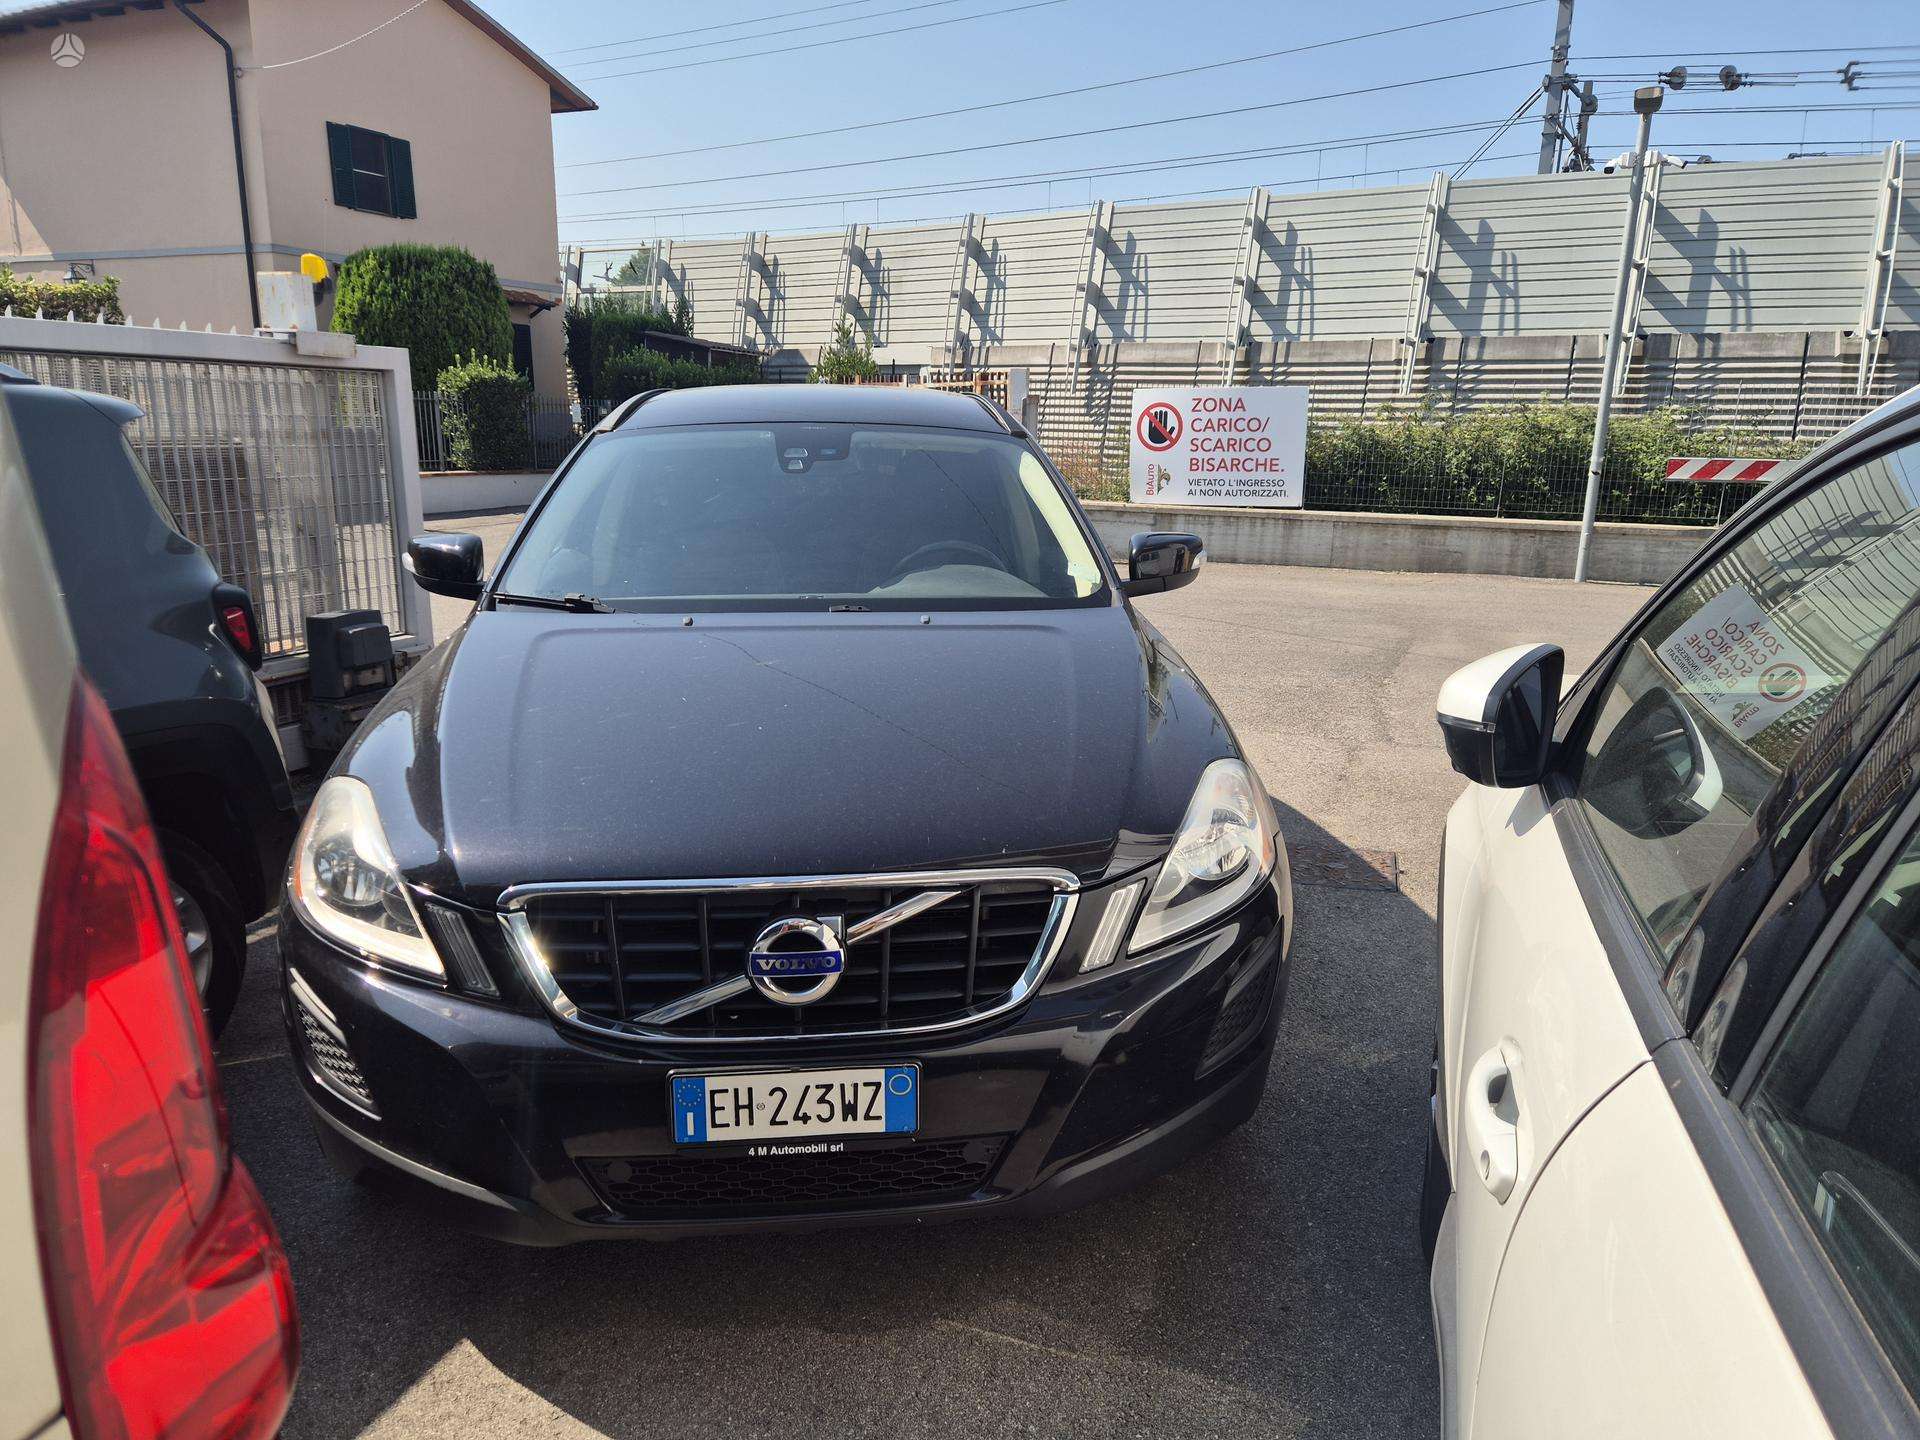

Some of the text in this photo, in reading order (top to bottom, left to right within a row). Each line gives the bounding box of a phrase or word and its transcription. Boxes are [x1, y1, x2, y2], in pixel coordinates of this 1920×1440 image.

[1191, 397, 1247, 413] ZONA
[1190, 416, 1270, 433] CARICO/
[1190, 437, 1272, 453] SCARICO
[1189, 457, 1285, 473] BISARCHE.
[1188, 478, 1285, 488] VIETATO L'INGRESSO
[1200, 489, 1222, 497] NON
[1224, 489, 1289, 498] AUTORIZZATI.
[756, 956, 837, 971] VOLVO
[709, 1081, 883, 1129] EH 243WZ
[748, 1142, 844, 1156] 4 M Automobili srl
